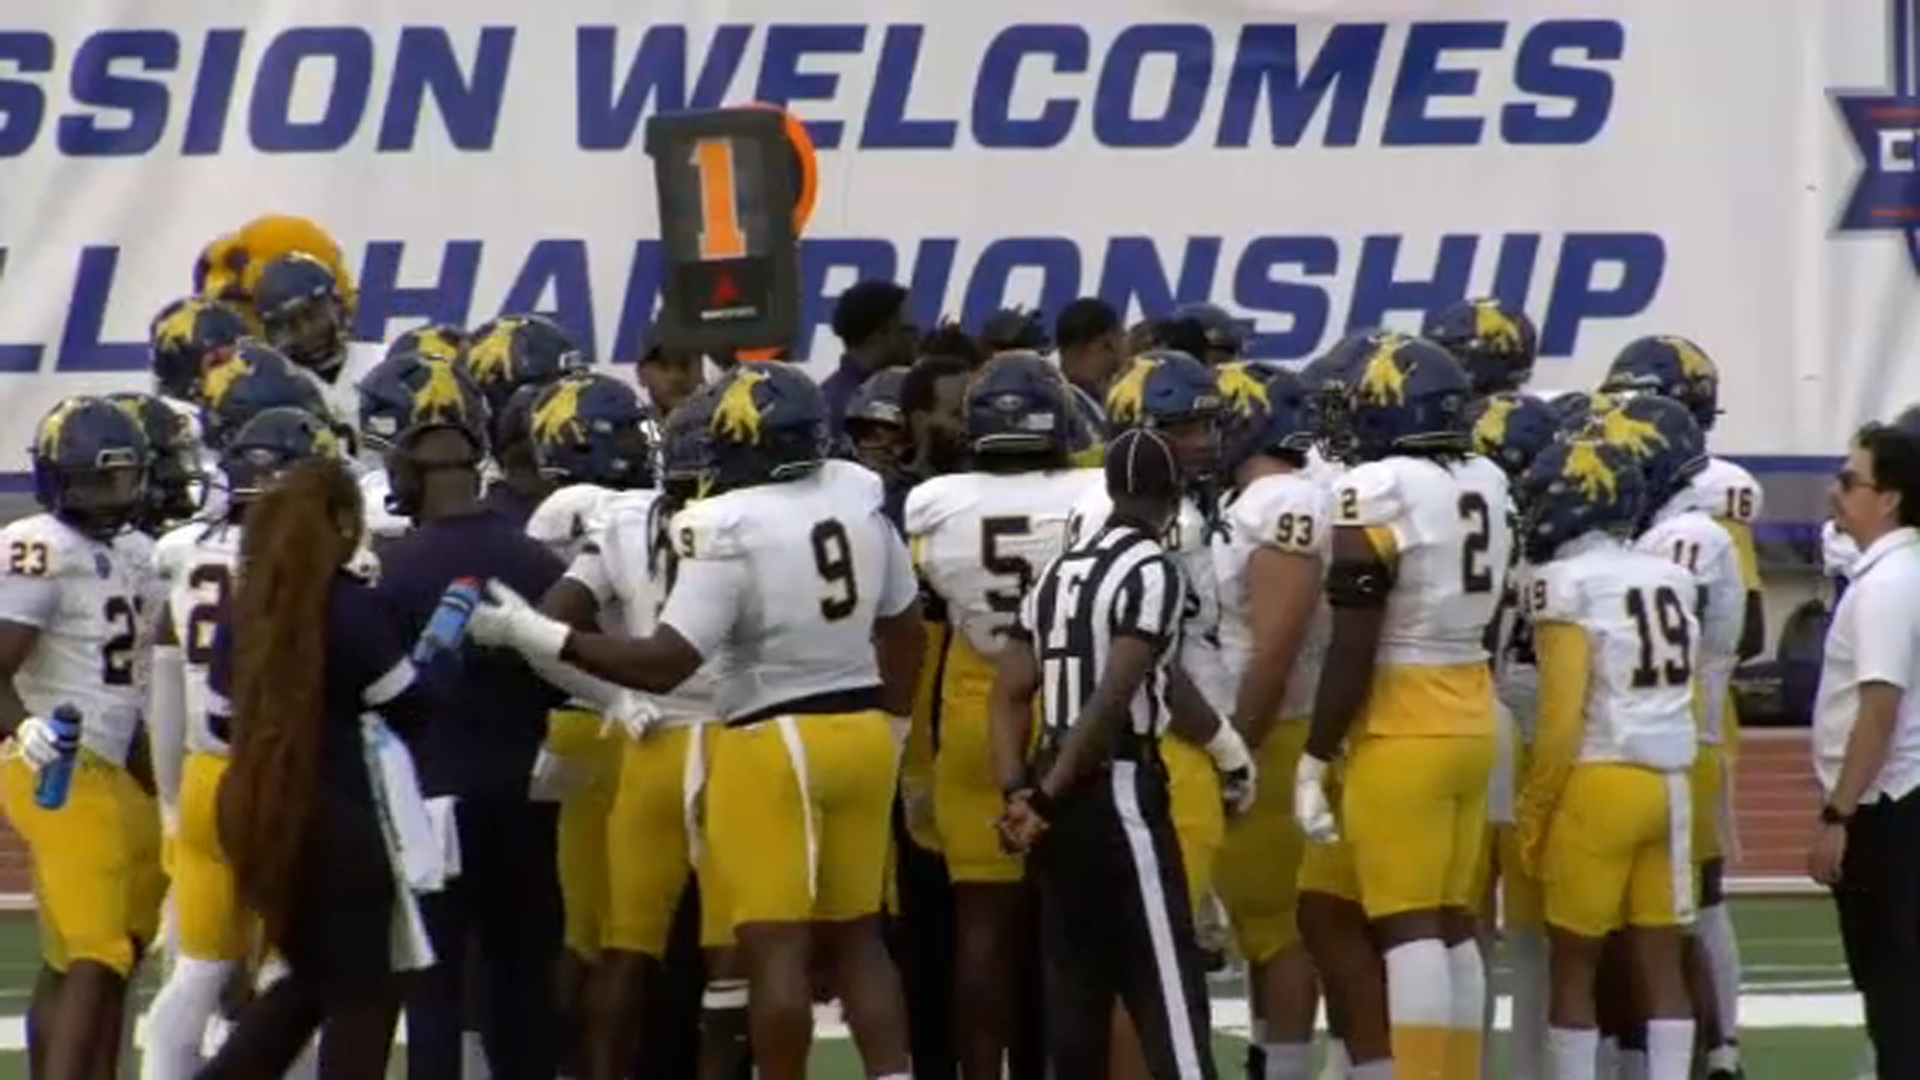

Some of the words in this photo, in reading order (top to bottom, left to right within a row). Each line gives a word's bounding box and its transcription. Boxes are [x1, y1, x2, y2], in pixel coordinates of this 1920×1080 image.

[576, 20, 1626, 150] WELCOMES
[1877, 130, 1920, 172] C
[687, 137, 747, 261] 1
[193, 233, 1666, 364] HAPIONSHIP
[681, 527, 695, 558] 9
[1276, 512, 1314, 548] 93
[1341, 487, 1358, 520] 2
[1457, 491, 1493, 594] 2
[1726, 487, 1753, 518] 16
[10, 541, 48, 576] 23
[811, 518, 859, 620] 9
[982, 515, 1033, 613] 5
[1047, 557, 1098, 648] F
[1672, 540, 1701, 576] 11
[103, 596, 144, 685] 2
[1625, 586, 1692, 689] 19
